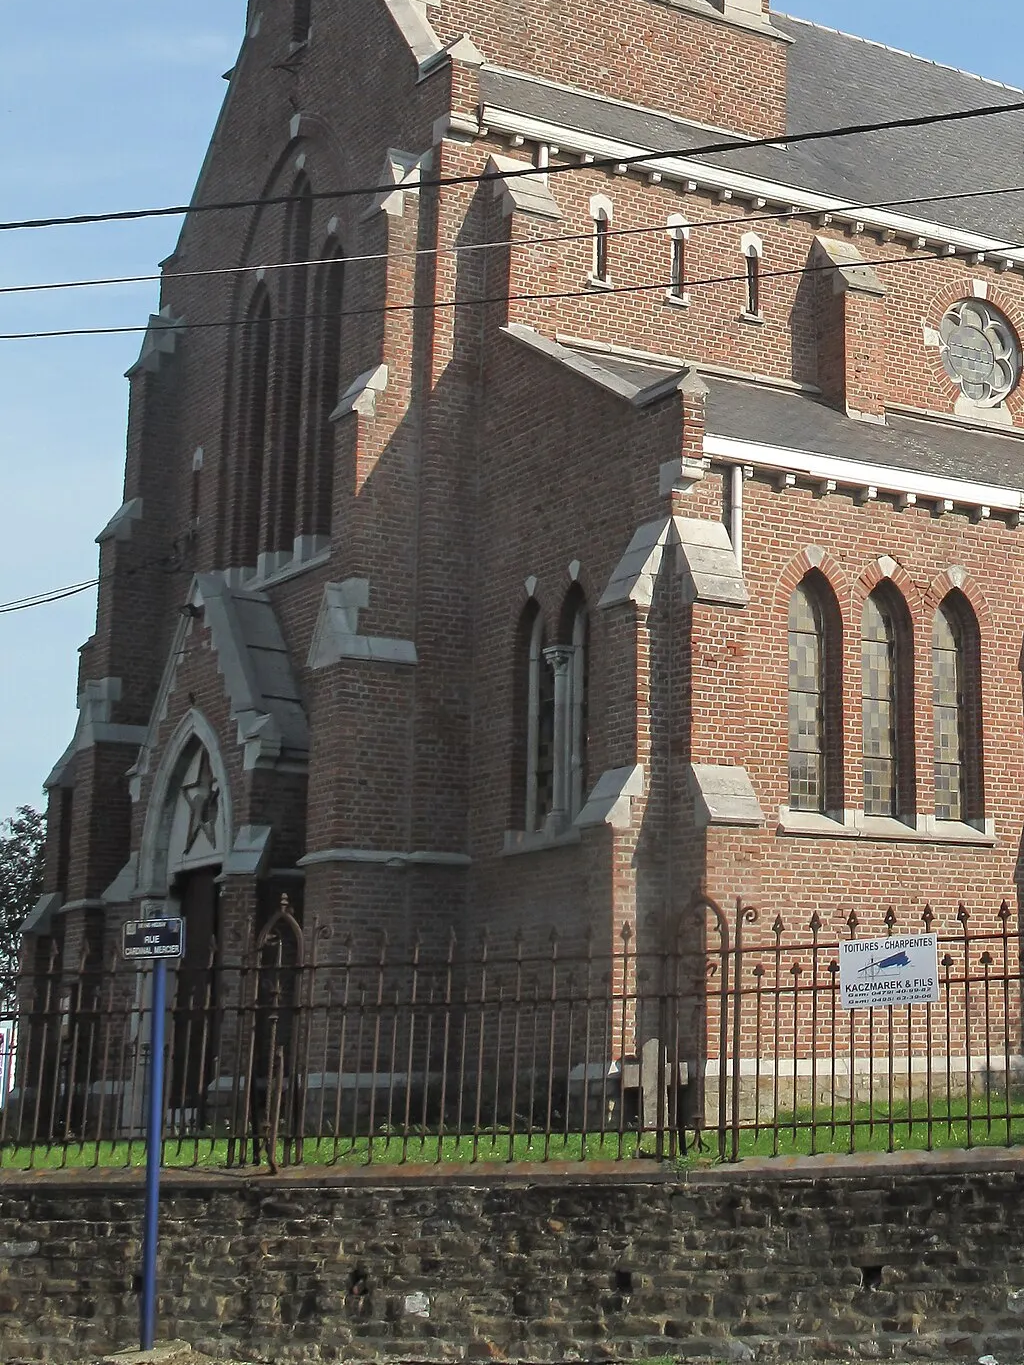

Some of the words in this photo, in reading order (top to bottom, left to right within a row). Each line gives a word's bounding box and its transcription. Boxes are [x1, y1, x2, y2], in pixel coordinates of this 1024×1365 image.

[144, 935, 160, 943] RUE
[125, 947, 153, 956] CARDINAL
[154, 945, 179, 954] MERCIER
[843, 942, 878, 953] TOITURES
[884, 938, 933, 949] CHARPENTES
[845, 981, 902, 992] KACZMAREK
[905, 980, 911, 988] &
[914, 978, 933, 987] FILS
